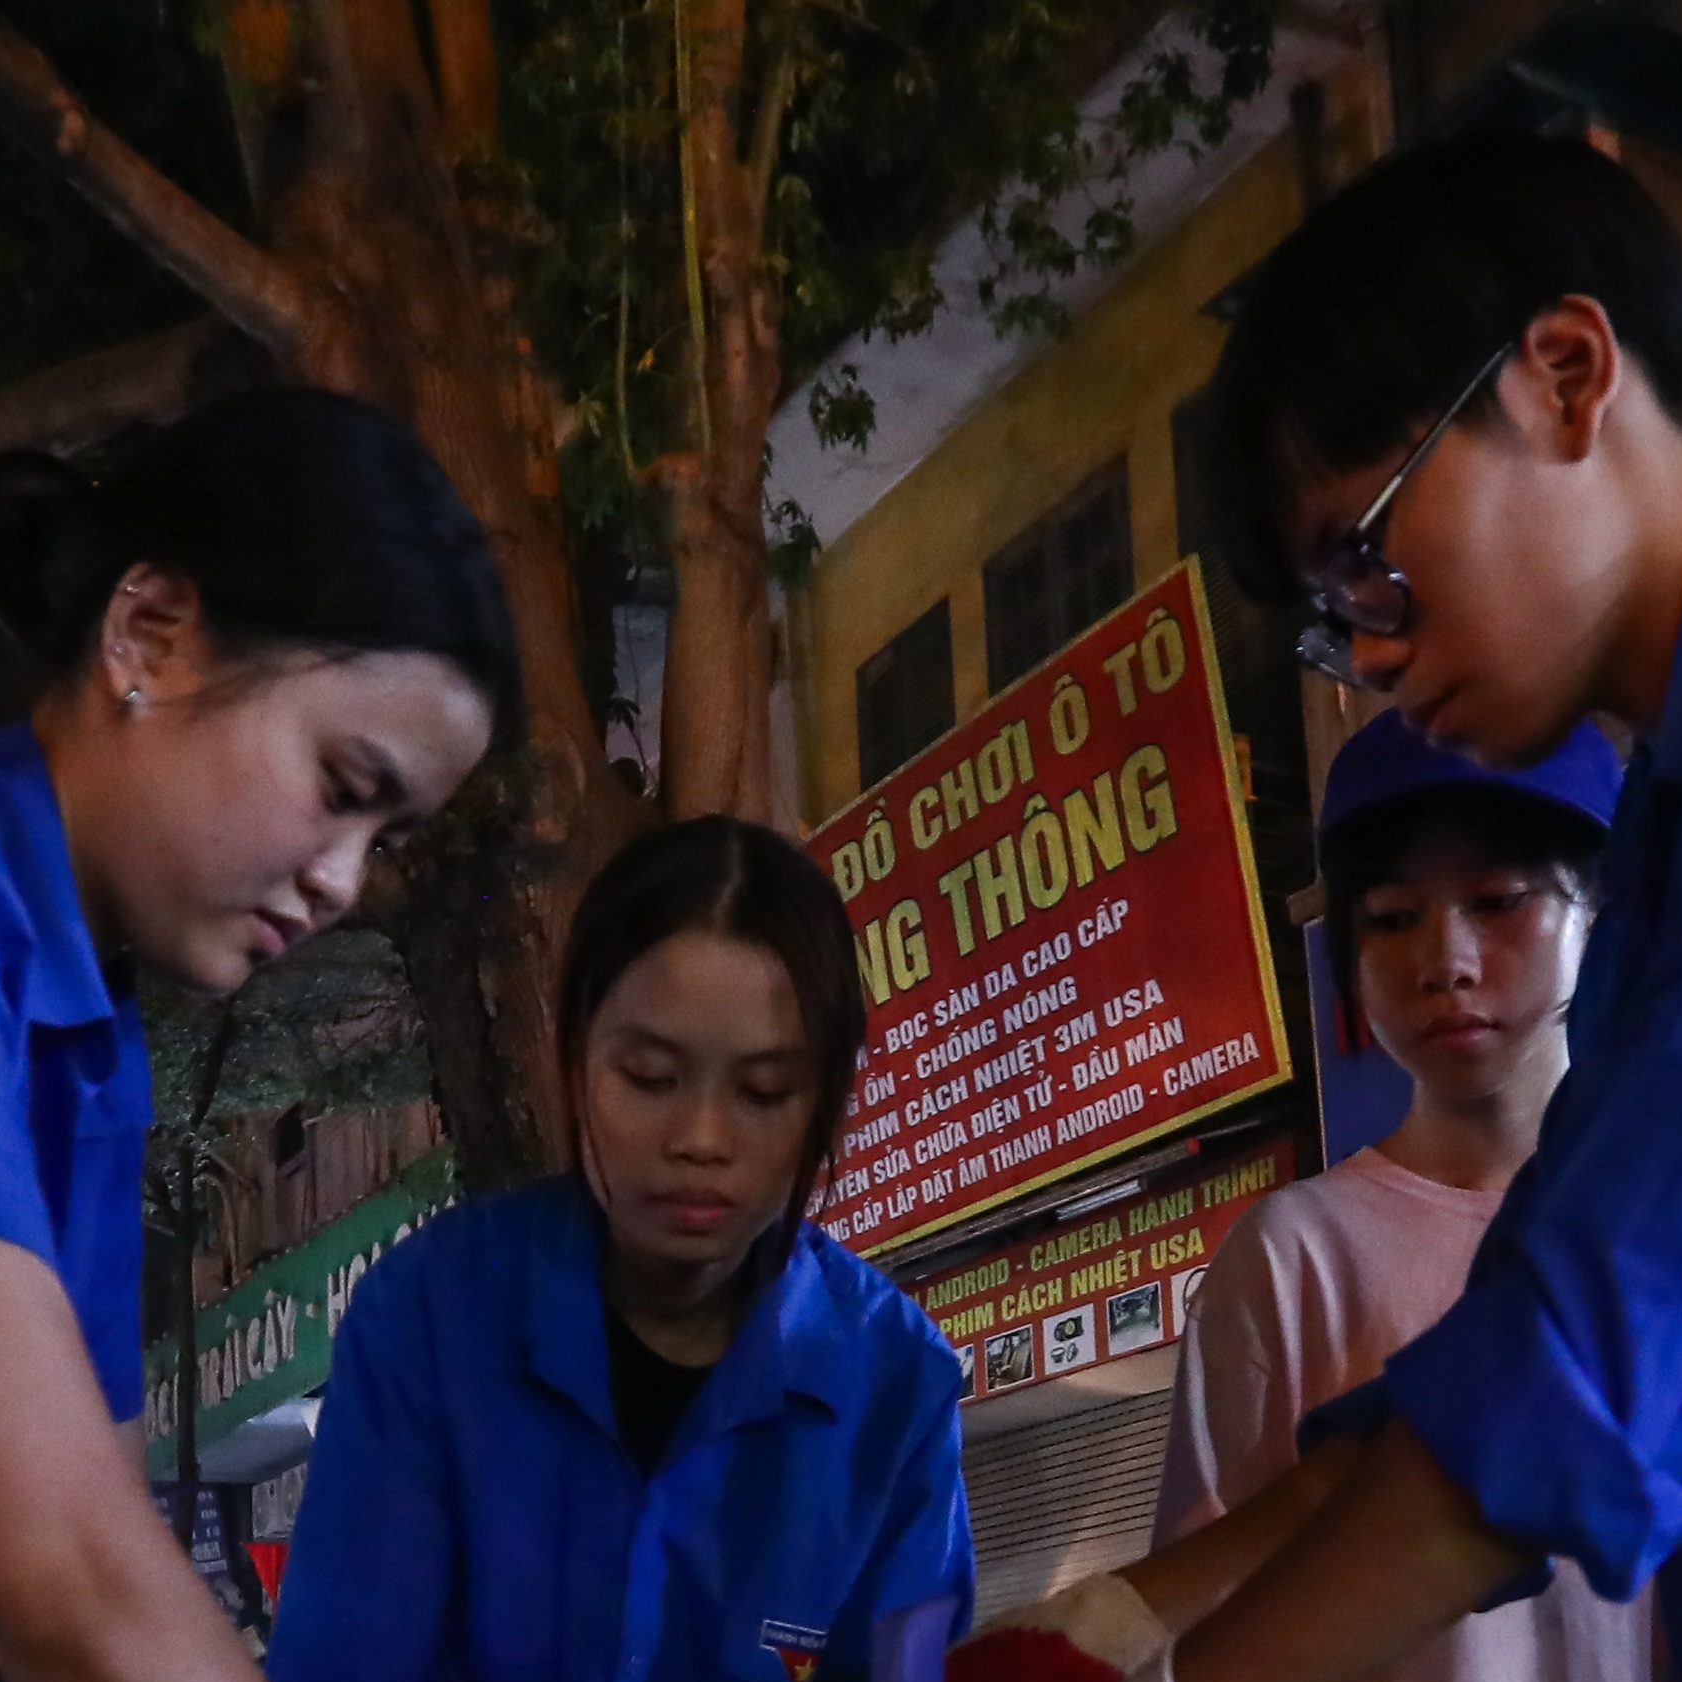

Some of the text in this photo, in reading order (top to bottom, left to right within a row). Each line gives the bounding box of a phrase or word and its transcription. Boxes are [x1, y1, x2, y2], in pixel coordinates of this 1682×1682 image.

[831, 606, 1187, 902] ĐỒ CHƠI Ô TÔ
[939, 744, 1179, 958] THÔNG
[885, 1010, 930, 1056] BỌC
[985, 966, 1018, 998] DA
[1023, 932, 1072, 979] CAO
[1078, 897, 1130, 949] CẤP
[916, 1024, 998, 1079] CHỐNG
[1003, 974, 1078, 1031] NÓNG
[843, 1111, 900, 1158] PHIM
[905, 1080, 970, 1131] CÁCH
[973, 1034, 1047, 1097] NHIỆT
[1054, 1011, 1098, 1055] 3M
[1104, 978, 1165, 1030] USA
[873, 1145, 912, 1186] SỬA
[914, 1121, 968, 1165] CHỮA
[971, 1092, 1021, 1139] ĐIỆN
[1072, 1043, 1120, 1092] ĐẦU
[1125, 1015, 1185, 1070] MÀN
[958, 1153, 988, 1189] ÂM
[990, 1125, 1053, 1173] THANH
[1057, 1083, 1144, 1144] ANDROID
[1163, 1031, 1260, 1097] CAMERA
[926, 1258, 1010, 1312] ANDROID
[1029, 1215, 1122, 1272] CAMERA
[939, 1226, 1205, 1340] PHIM CÁCH NHIỆT USA
